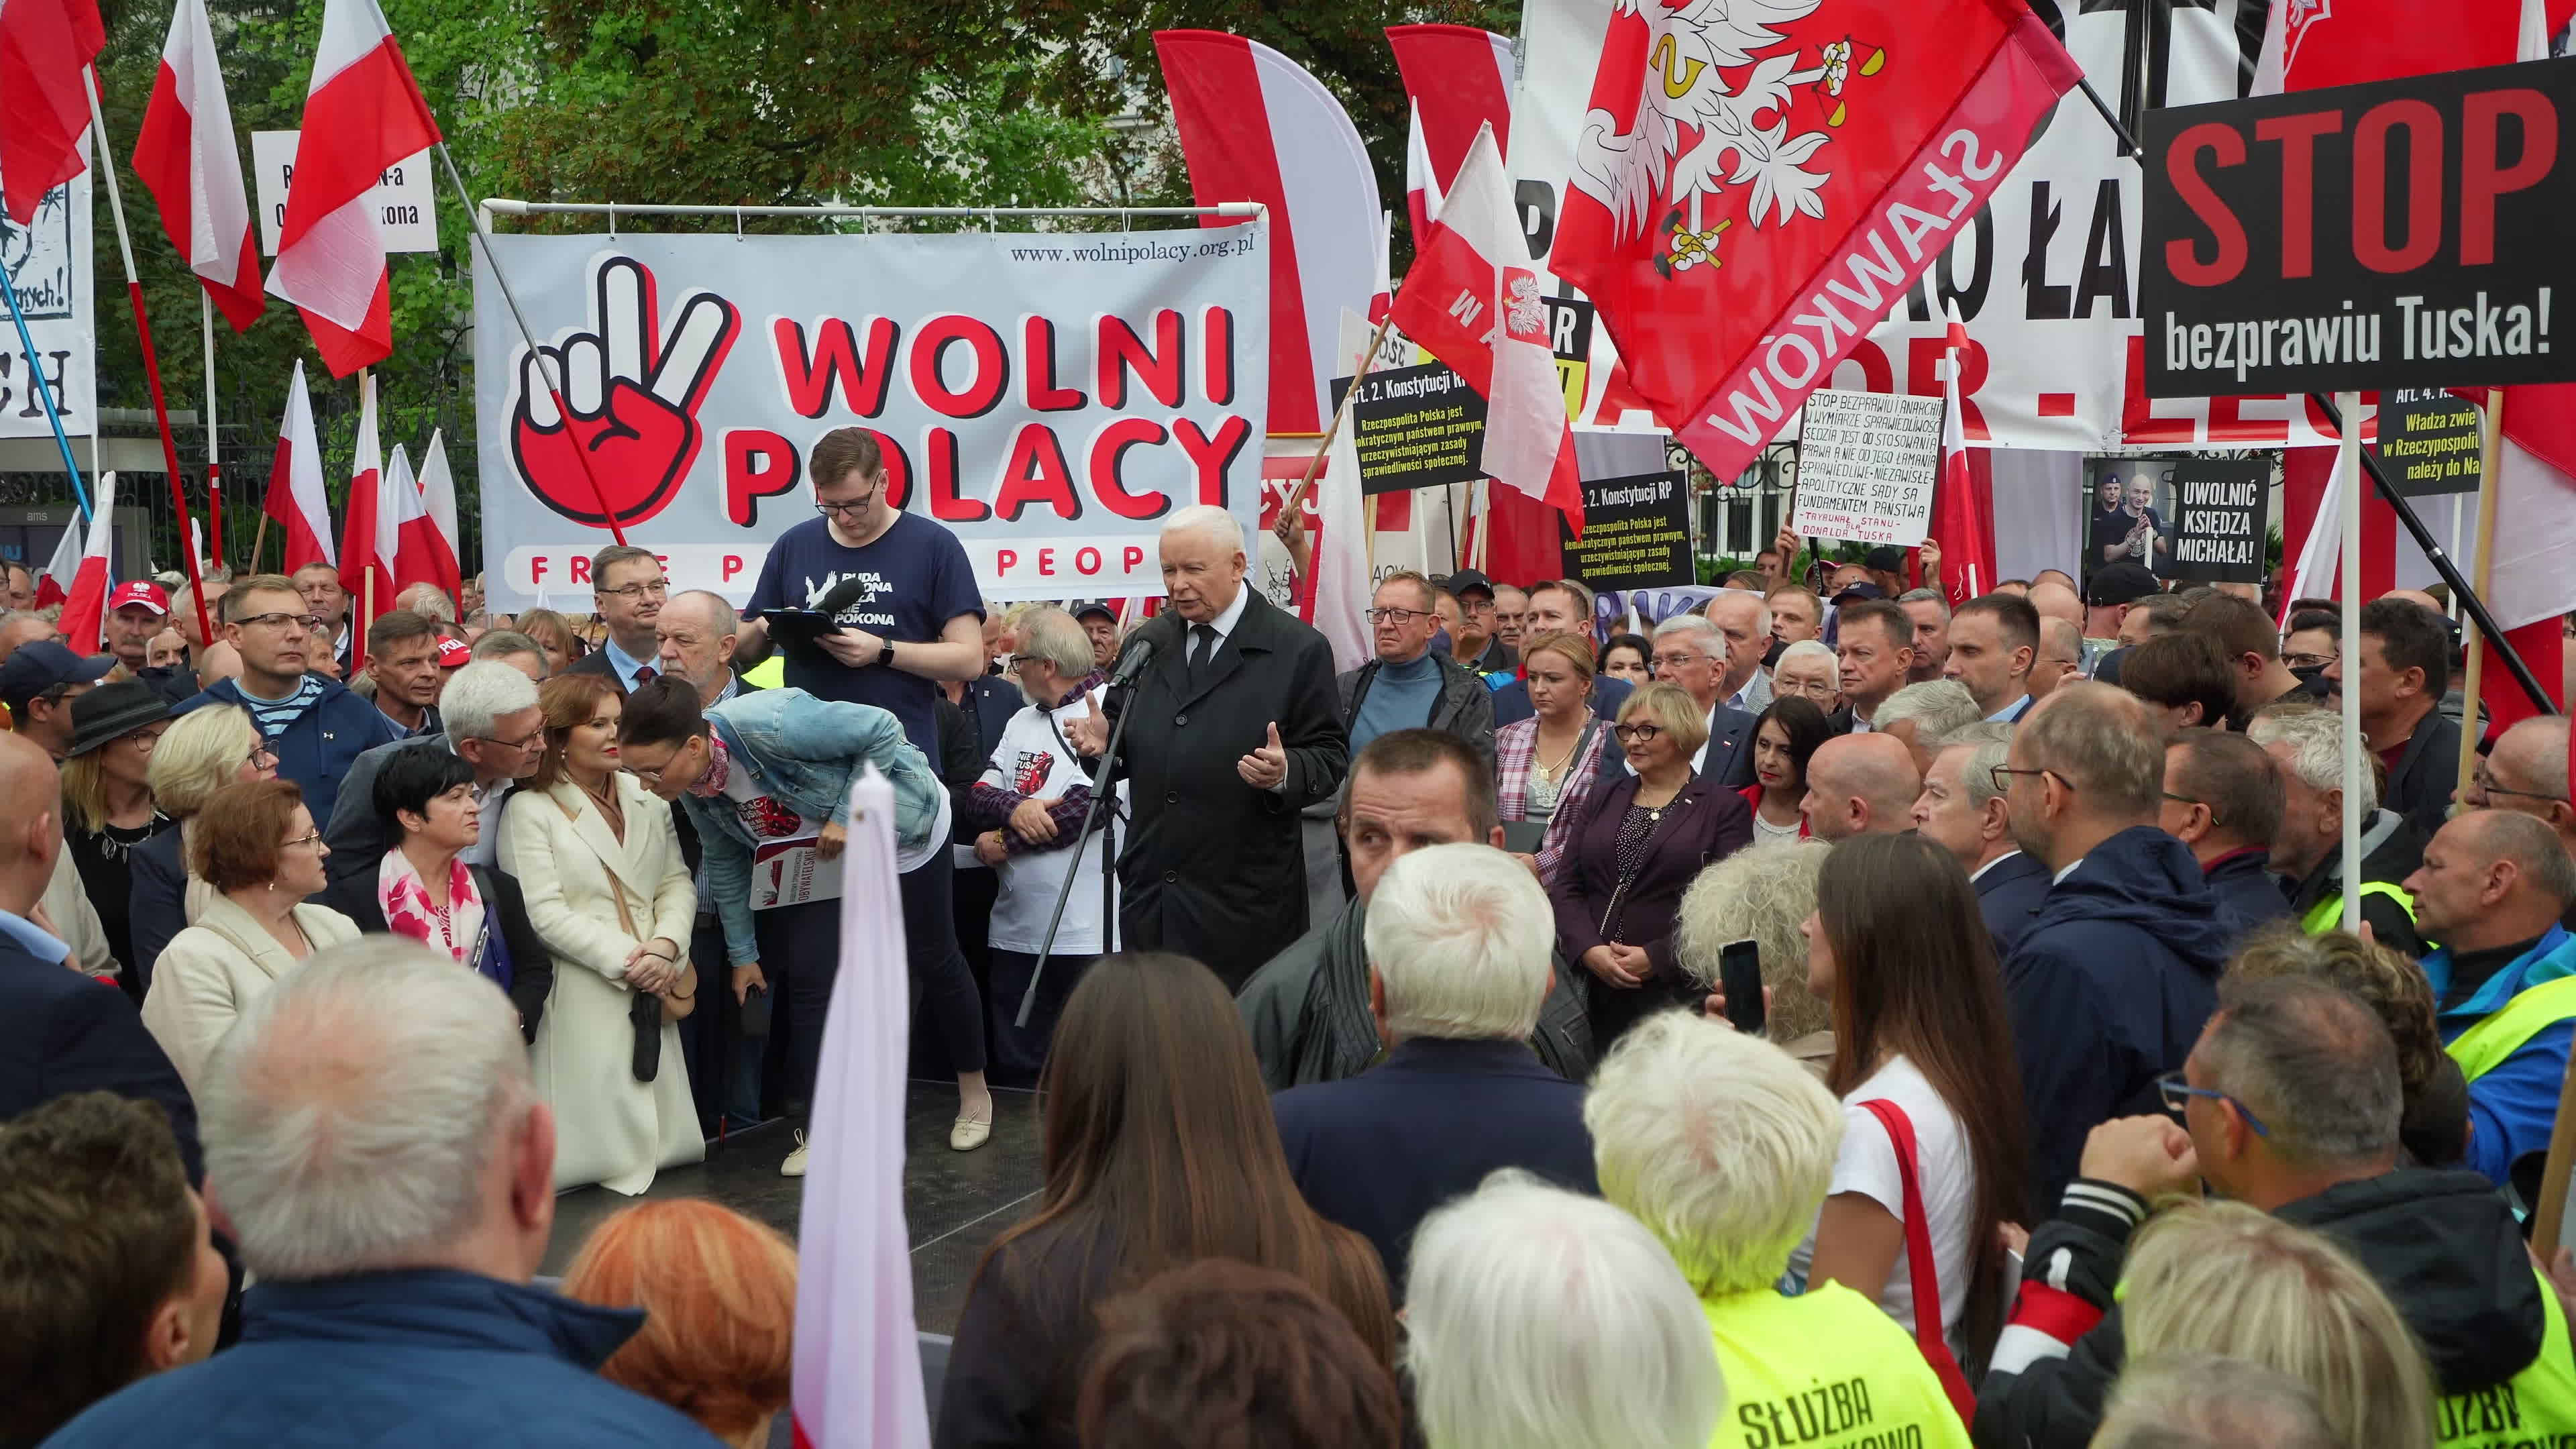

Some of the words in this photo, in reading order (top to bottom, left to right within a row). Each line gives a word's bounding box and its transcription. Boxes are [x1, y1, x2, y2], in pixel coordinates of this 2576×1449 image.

[2165, 88, 2559, 286] STOP
[1012, 233, 1254, 264] www.wolnipolacy.org.pl
[2167, 302, 2380, 382] bezprawiu
[2396, 288, 2551, 361] Tuska!
[774, 305, 1235, 419] WOLNI
[1371, 382, 1383, 401] 2.
[1386, 370, 1451, 399] Konstytucji
[1809, 392, 1837, 408] STOP
[1362, 413, 1417, 432] Rzeczpospolita
[1419, 408, 1446, 423] Polska
[1447, 405, 1463, 421] jest
[1805, 409, 1813, 424] W
[1814, 409, 1862, 428] WYMIARZE
[2406, 412, 2447, 432] Władza
[1406, 425, 1444, 443] państwem
[1447, 419, 1485, 435] prawnym,
[1862, 432, 1874, 445] OD
[1875, 431, 1937, 451] STOSOWANIA
[1360, 441, 1439, 462] urzeczywistniającym
[1441, 437, 1467, 452] zasady
[1802, 443, 1831, 459] PRAWA
[1834, 446, 1841, 460] A
[1842, 447, 1856, 462] NIE
[1858, 449, 1870, 462] OD
[1871, 450, 1894, 464] JEGO
[2383, 443, 2393, 458] w
[1362, 458, 1422, 478] sprawiedliwości
[1424, 451, 1469, 470] społecznej.
[2407, 460, 2443, 482] należy
[2446, 458, 2461, 476] do
[1589, 489, 1599, 508] 2.
[1601, 482, 1656, 508] Konstytucji
[1658, 480, 1672, 500] RP
[2184, 479, 2257, 507] UWOLNIĆ
[27, 512, 48, 522] ams
[1798, 494, 1868, 514] FUNDAMENTEM
[1874, 498, 1925, 519] PAŃSTWA
[1630, 517, 1652, 529] Polska
[1653, 515, 1668, 529] jest
[1803, 525, 1849, 537] DONALDA
[1858, 530, 1893, 543] TUSKA
[2184, 510, 2251, 539] KSIĘDZA
[1618, 533, 1652, 548] państwem
[1648, 545, 1671, 559] zasady
[2176, 539, 2254, 564] MICHAŁA!
[1581, 561, 1631, 581] sprawiedliwości
[834, 613, 895, 626] POKONA
[1738, 1377, 1874, 1449] SŁUŻBA
